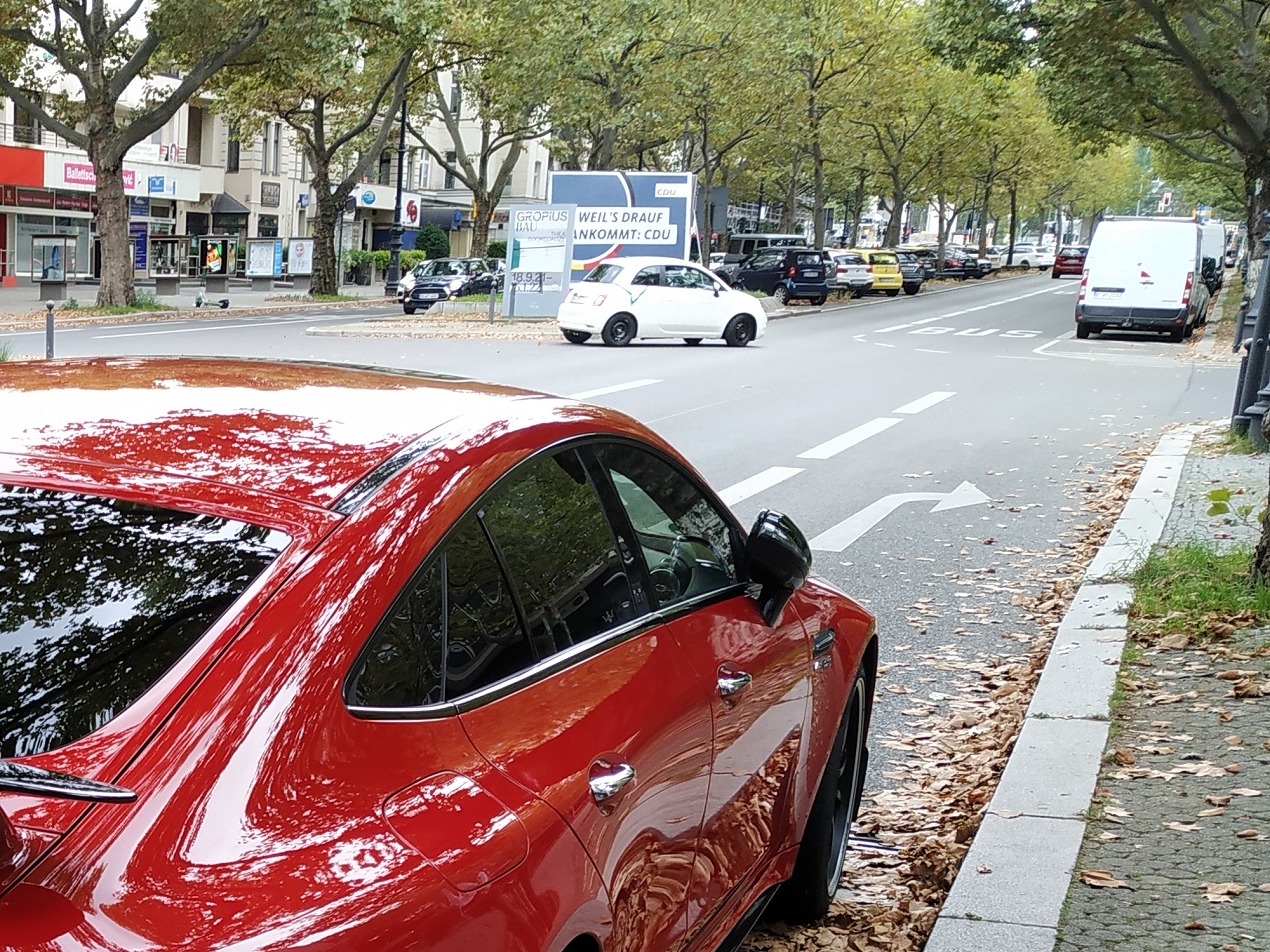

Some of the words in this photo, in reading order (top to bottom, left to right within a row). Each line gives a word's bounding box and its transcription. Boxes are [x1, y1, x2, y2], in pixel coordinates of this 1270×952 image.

[579, 212, 618, 223] WEIL'S
[621, 212, 663, 223] DRAUF
[515, 222, 538, 232] BAU
[573, 229, 641, 240] ANKOMMT:
[644, 229, 671, 240] CDU
[907, 326, 1044, 338] BUS
